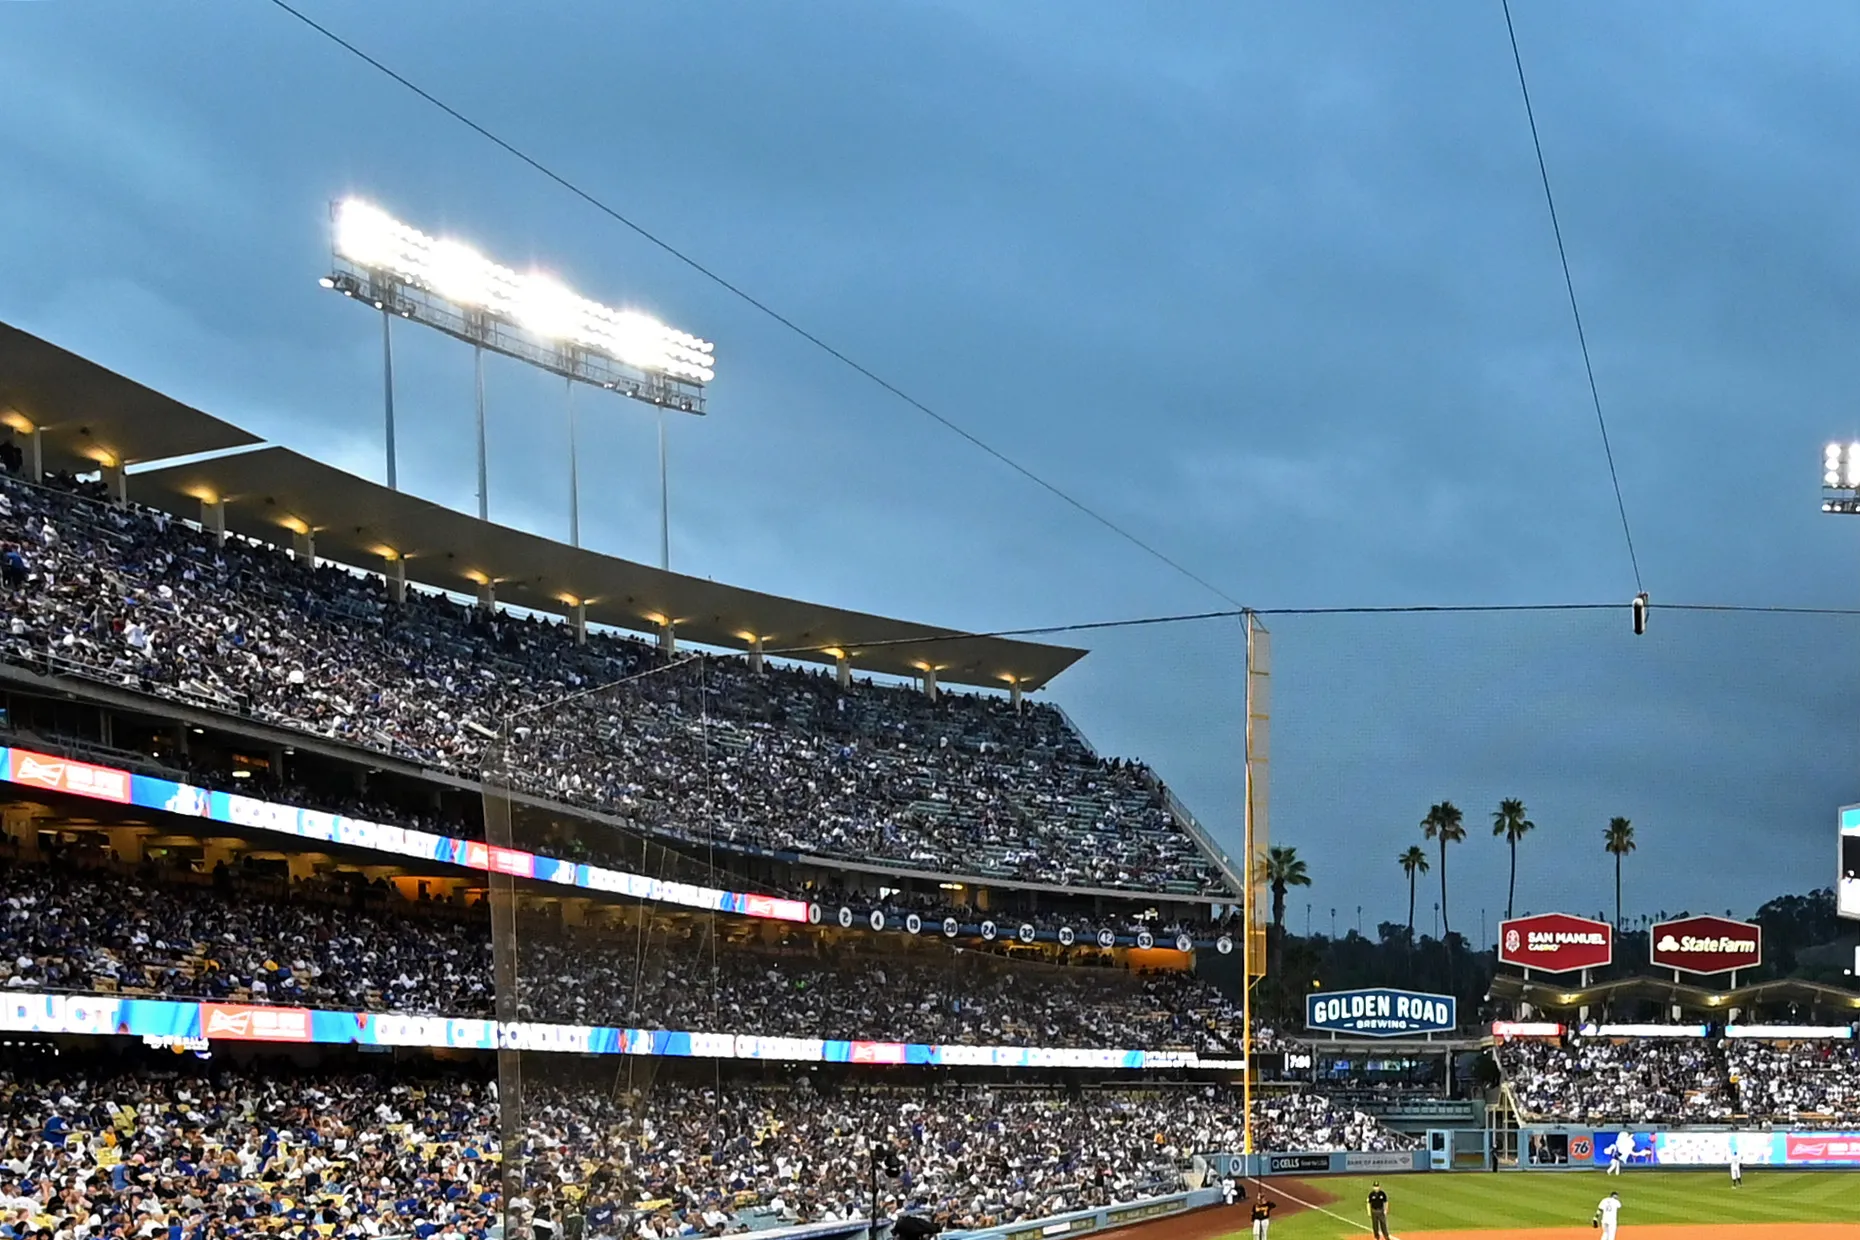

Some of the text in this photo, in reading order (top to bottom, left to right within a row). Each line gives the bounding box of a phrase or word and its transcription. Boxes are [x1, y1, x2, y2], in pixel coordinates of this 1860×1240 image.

[811, 904, 818, 919] 1
[843, 909, 850, 923] 2
[873, 912, 881, 927] 4
[908, 916, 920, 930] 19
[944, 920, 957, 934] 20
[982, 923, 997, 937] 24
[1020, 926, 1035, 940] 32
[1099, 932, 1115, 945] 42
[1528, 932, 1606, 945] SAN MANUEL
[1314, 995, 1448, 1025] GOLDEN ROAD
[1356, 1019, 1408, 1029] BREWING
[1573, 1141, 1589, 1154] 76
[1281, 1158, 1299, 1168] CELLS
